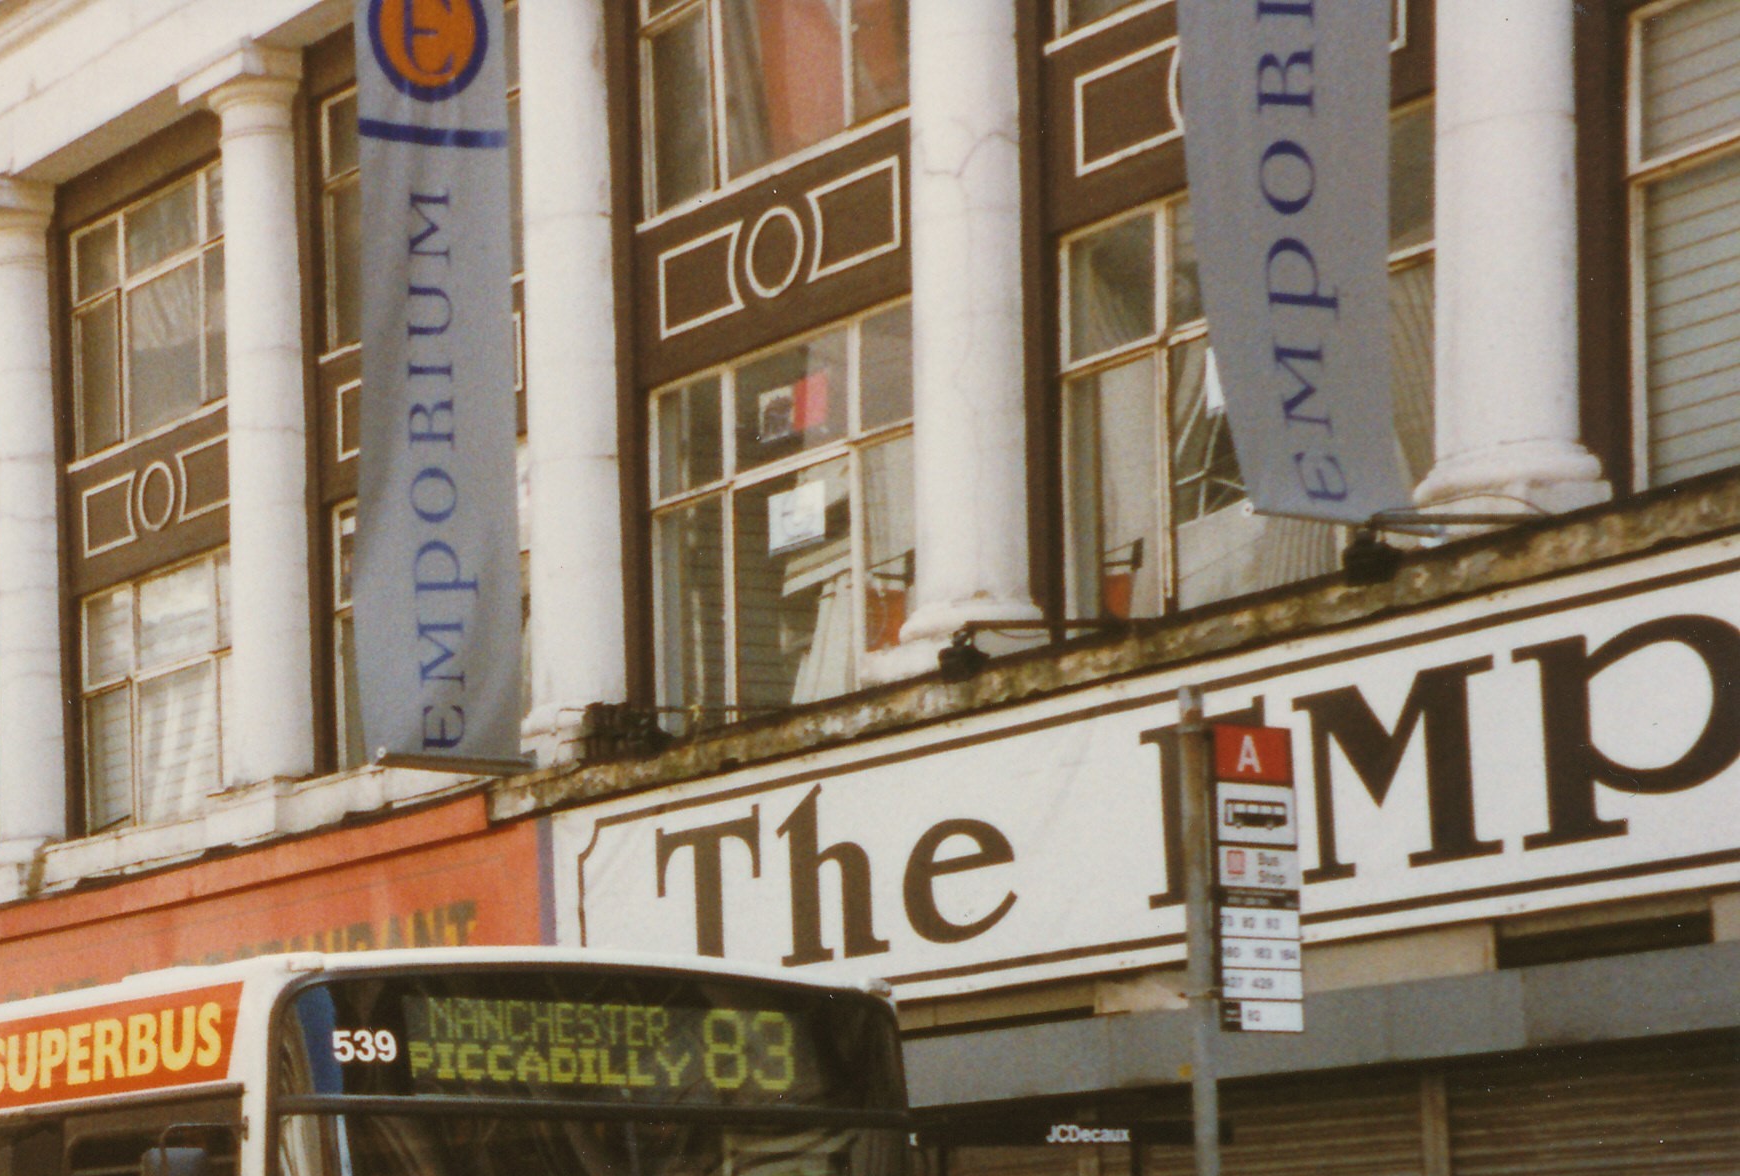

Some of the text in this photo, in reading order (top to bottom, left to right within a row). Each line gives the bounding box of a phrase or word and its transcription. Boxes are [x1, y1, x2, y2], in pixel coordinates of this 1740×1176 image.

[408, 191, 479, 752] EMPORIUM
[1236, 734, 1261, 773] A
[654, 782, 1018, 968] The
[1257, 869, 1286, 885] Stop
[332, 1029, 397, 1063] 539
[408, 1040, 691, 1087] PICCADILLY
[703, 1008, 796, 1091] 83
[1046, 1124, 1131, 1143] JCDecaux
